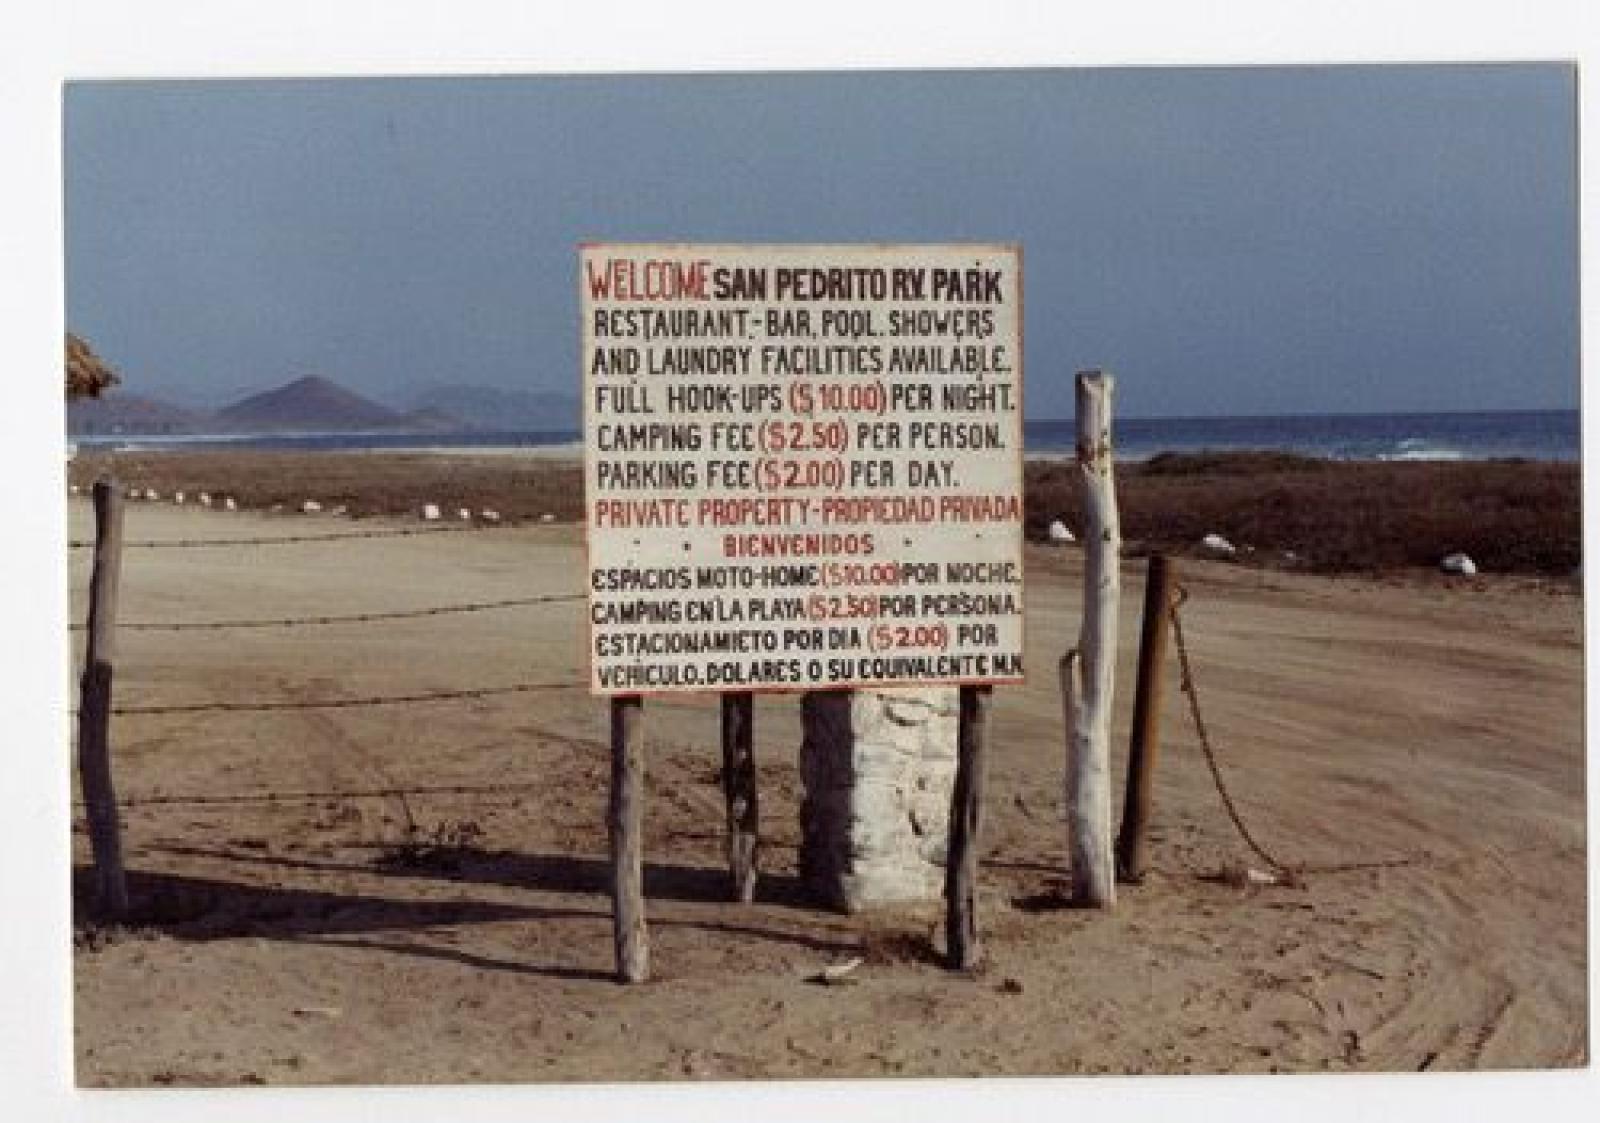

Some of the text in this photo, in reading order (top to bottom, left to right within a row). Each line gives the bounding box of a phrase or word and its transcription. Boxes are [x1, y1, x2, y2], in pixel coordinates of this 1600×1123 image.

[586, 259, 711, 301] WELCOME
[713, 268, 766, 300] SAN
[777, 268, 887, 300] PEDRITO
[932, 268, 1003, 303] PARK
[889, 309, 996, 340] SHOWERS
[592, 346, 641, 375] AND
[646, 346, 752, 375] LAUNDRY
[761, 345, 883, 375] FACILITIES
[594, 384, 653, 413] FULL
[666, 384, 783, 413] HOOK-UPS
[891, 383, 932, 412] PER
[597, 422, 702, 451] CAMPING
[711, 421, 754, 450] FEE
[856, 421, 902, 450] PER
[597, 459, 698, 490] PARKING
[706, 459, 750, 488] FEE
[850, 459, 896, 488] PER
[595, 498, 690, 528] PRIVATE
[940, 495, 1021, 524] PRIVADA
[723, 534, 875, 558] BIENVENIDOS
[591, 567, 692, 591] ESPACIOS
[697, 565, 821, 590] MOTO-HOME
[901, 562, 940, 587] POR
[591, 599, 683, 625] CAMPING
[718, 598, 745, 622] LA
[748, 597, 806, 622] PLAYA
[878, 594, 917, 619] POR
[597, 631, 778, 657] ESTACIONAMIETO
[783, 629, 824, 651] POR
[828, 627, 862, 650] DIA
[957, 623, 1000, 647] POR
[706, 659, 801, 686] DOLARES
[828, 657, 855, 680] SU
